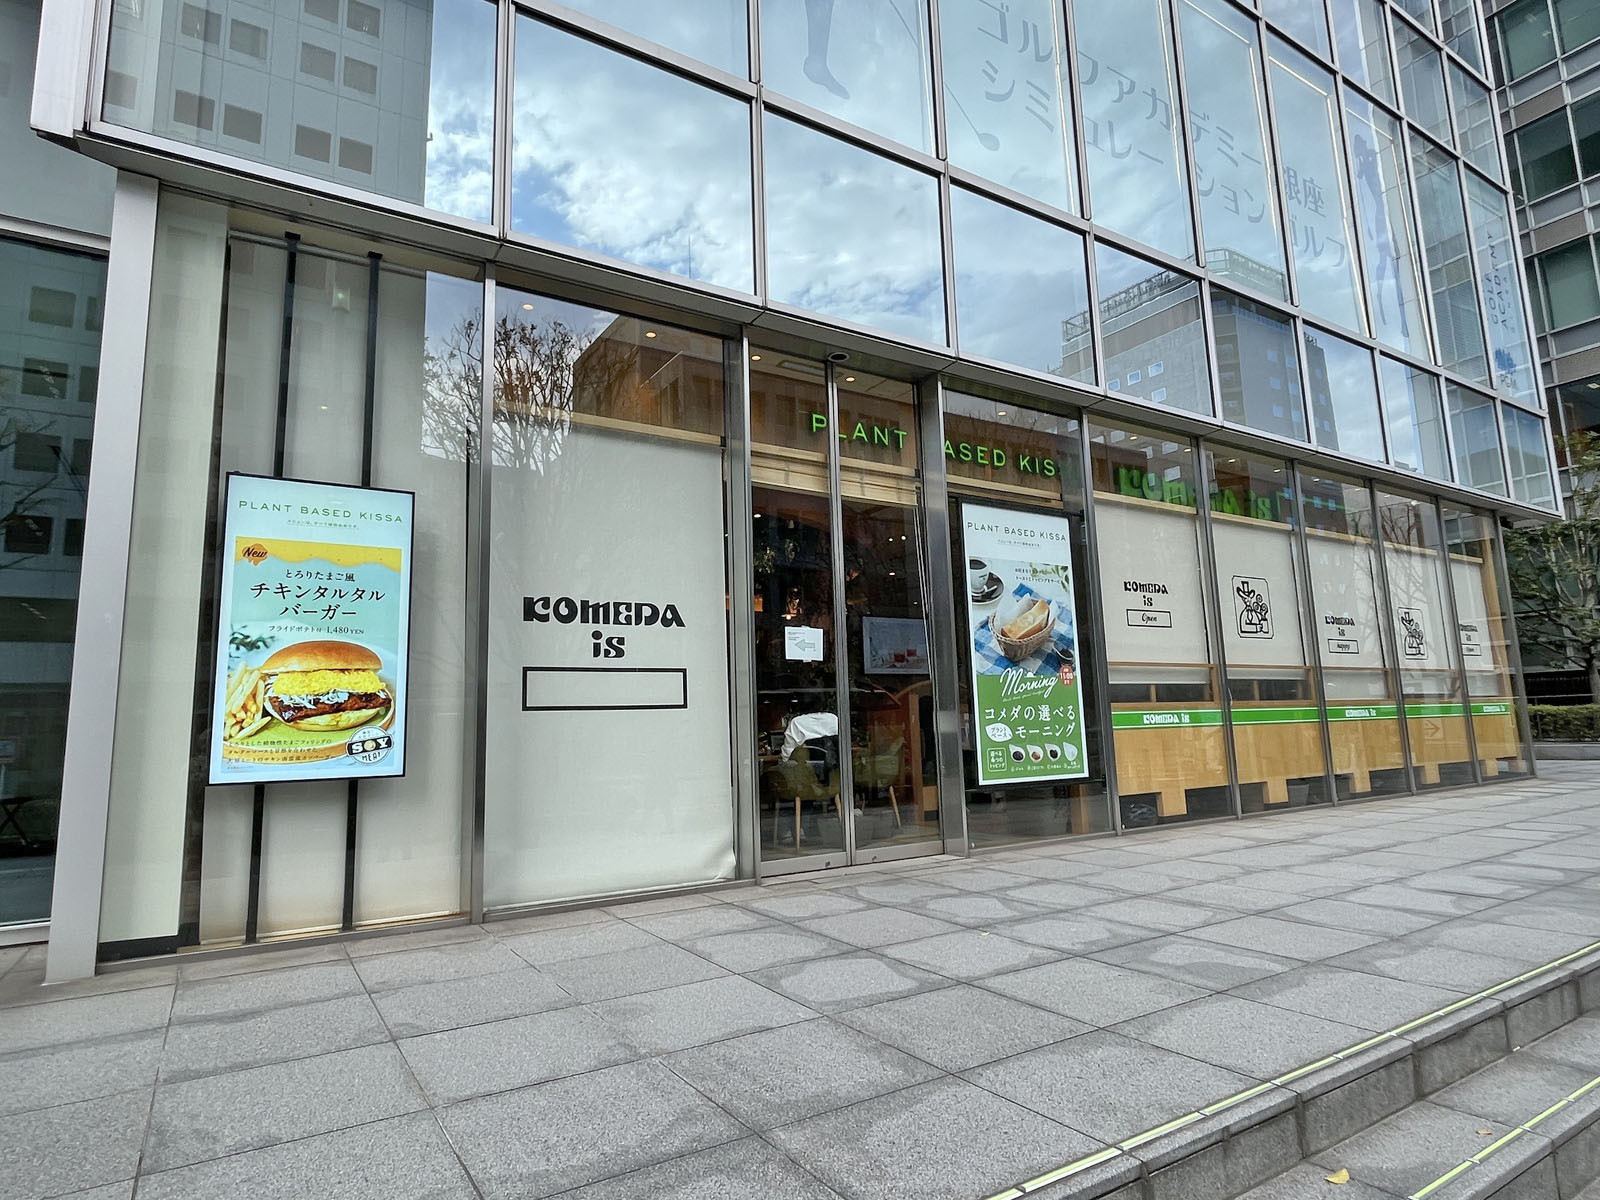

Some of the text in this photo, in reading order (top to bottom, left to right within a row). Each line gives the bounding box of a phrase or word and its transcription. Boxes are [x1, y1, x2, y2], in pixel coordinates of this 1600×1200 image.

[943, 439, 1007, 468] ASED
[1019, 453, 1057, 477] KIS
[238, 500, 403, 523] PLANT BASED KISSA
[967, 521, 1067, 542] PLANT BASED KISSA
[242, 546, 268, 559] New
[285, 568, 356, 583] とろりたまご風
[249, 581, 387, 603] チキンタルタル
[1123, 581, 1169, 595] KOMEDA
[1142, 595, 1153, 607] is
[279, 603, 357, 621] バーガー
[523, 596, 686, 628] KOMEDA
[1141, 612, 1158, 623] Open
[326, 625, 349, 635] 1,480
[591, 629, 626, 659] is
[999, 667, 1059, 699] Morning
[984, 704, 1076, 722] コメダの選べる
[1015, 722, 1076, 739] モーニング
